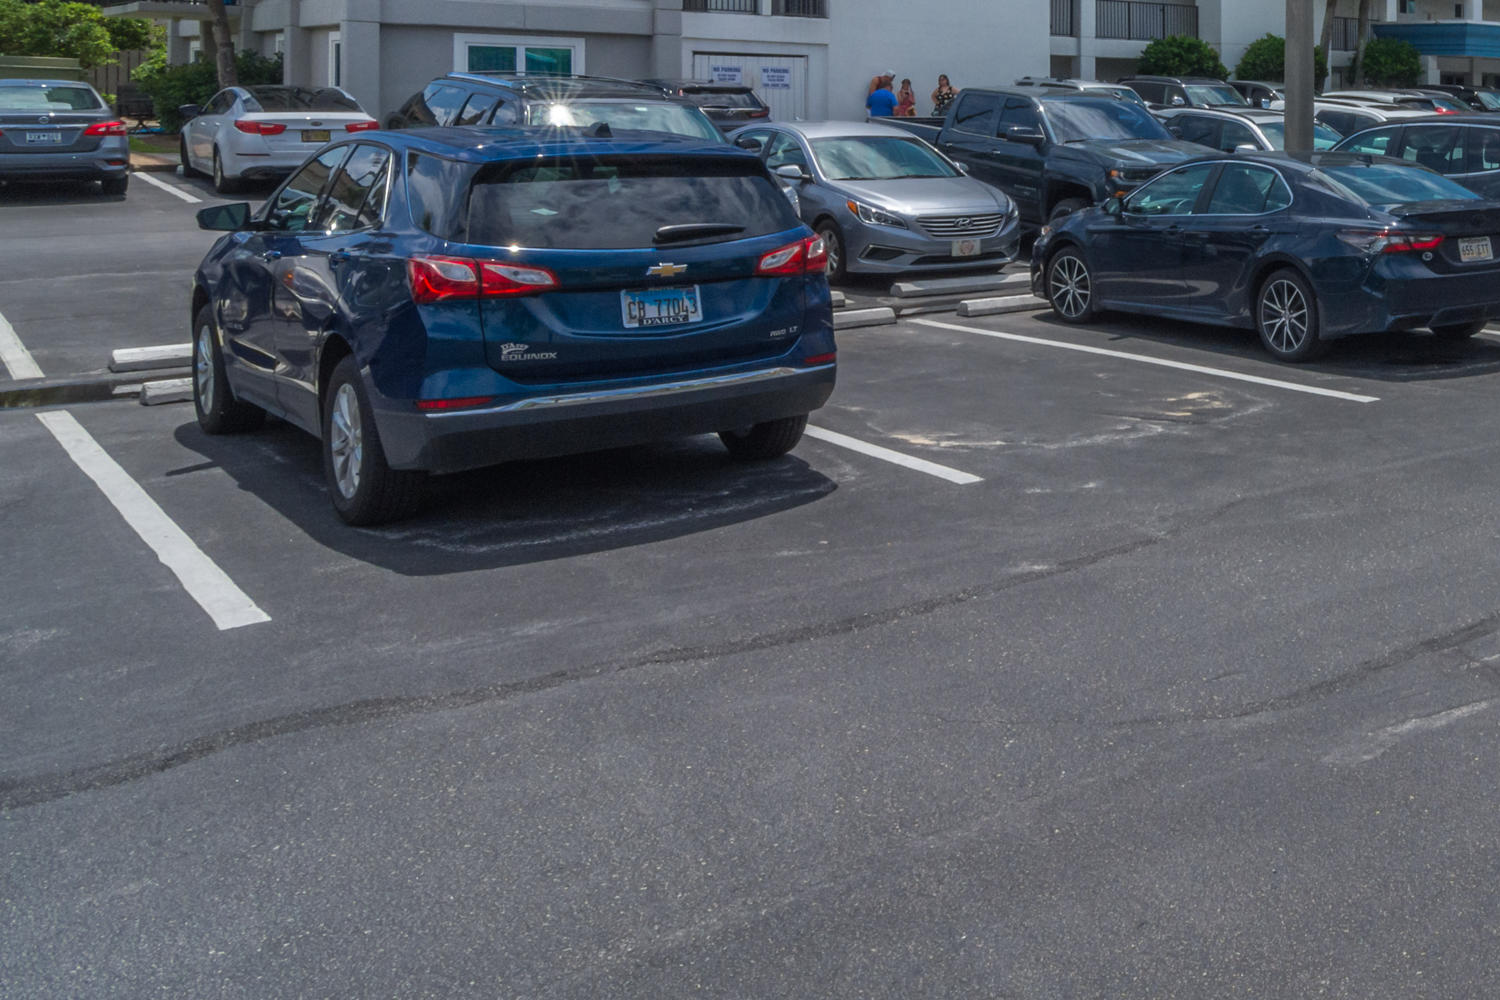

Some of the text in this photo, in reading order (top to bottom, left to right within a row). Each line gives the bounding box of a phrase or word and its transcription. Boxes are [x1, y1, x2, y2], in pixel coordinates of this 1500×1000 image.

[628, 296, 698, 320] CB 77043
[643, 316, 684, 325] D'ARCY
[789, 325, 798, 333] LT
[501, 352, 558, 361] EQUINOX
